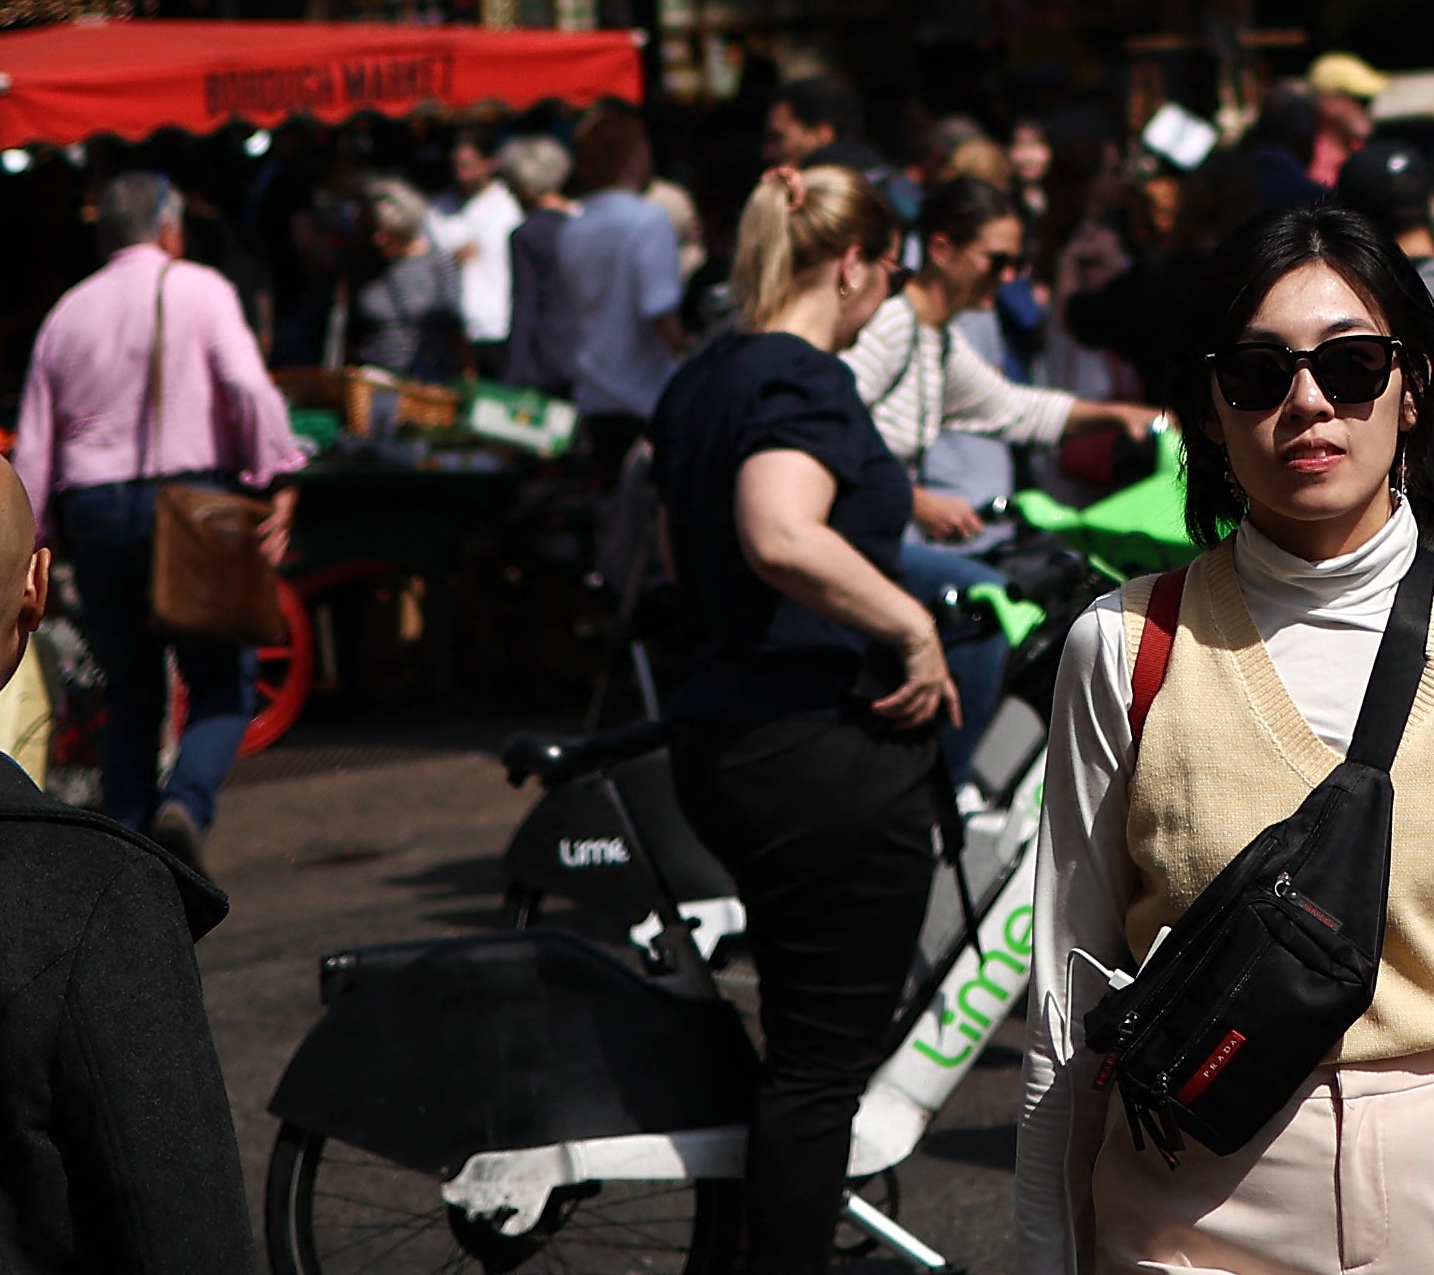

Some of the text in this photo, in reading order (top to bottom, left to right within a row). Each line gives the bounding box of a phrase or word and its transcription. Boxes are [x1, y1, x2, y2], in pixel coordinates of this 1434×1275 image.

[205, 65, 334, 118] BOROUGH
[560, 837, 631, 866] Lime
[912, 905, 1033, 1067] Lime
[1203, 1039, 1237, 1078] PRADA
